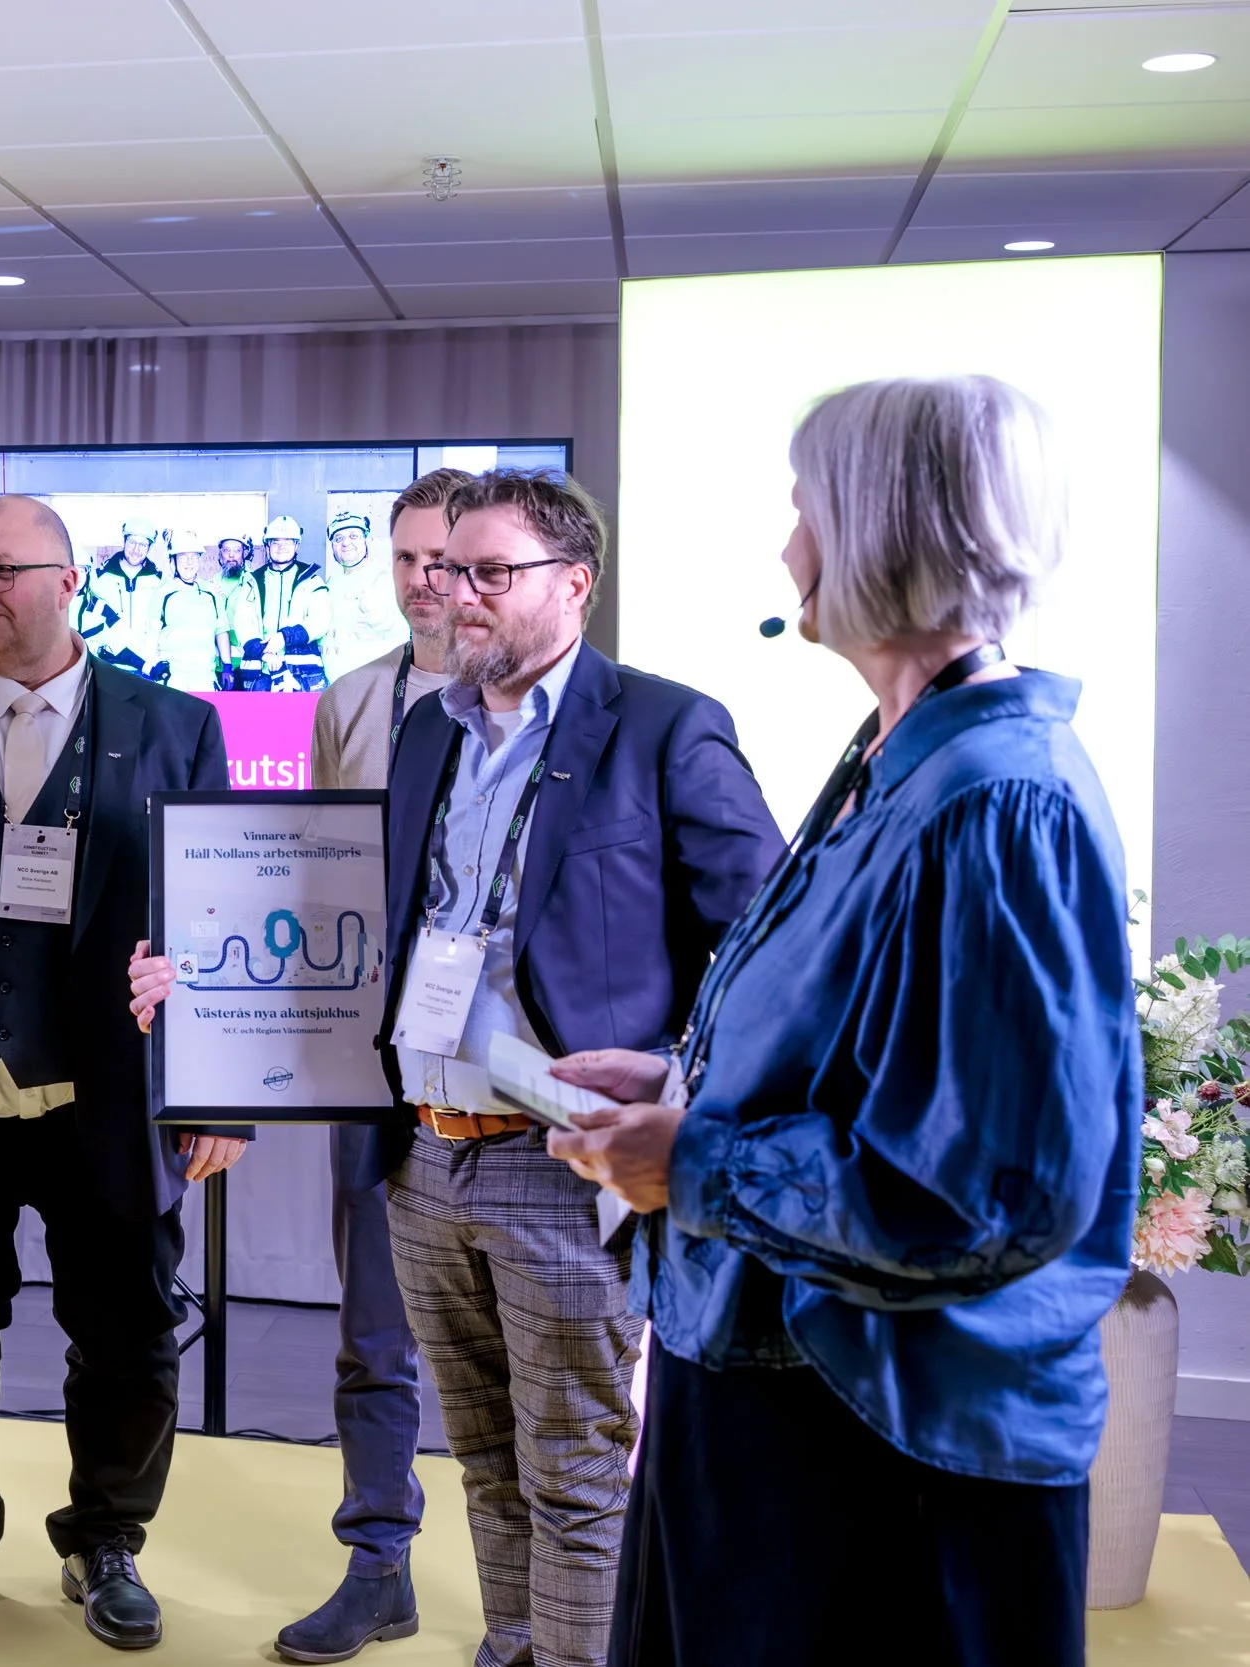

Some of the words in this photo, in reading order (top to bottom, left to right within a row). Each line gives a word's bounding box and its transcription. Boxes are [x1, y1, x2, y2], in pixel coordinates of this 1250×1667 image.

[243, 831, 287, 841] Vinnare
[288, 832, 301, 841] av
[185, 848, 210, 859] Håll
[213, 848, 261, 859] Nollans
[263, 846, 362, 860] arbetsmiljöpris
[256, 865, 291, 877] 2026
[194, 1007, 251, 1019] Västerås
[254, 1010, 277, 1021] nya
[280, 1007, 360, 1020] akutsjukhus
[255, 1027, 281, 1035] Region
[283, 1026, 332, 1034] Västmanland
